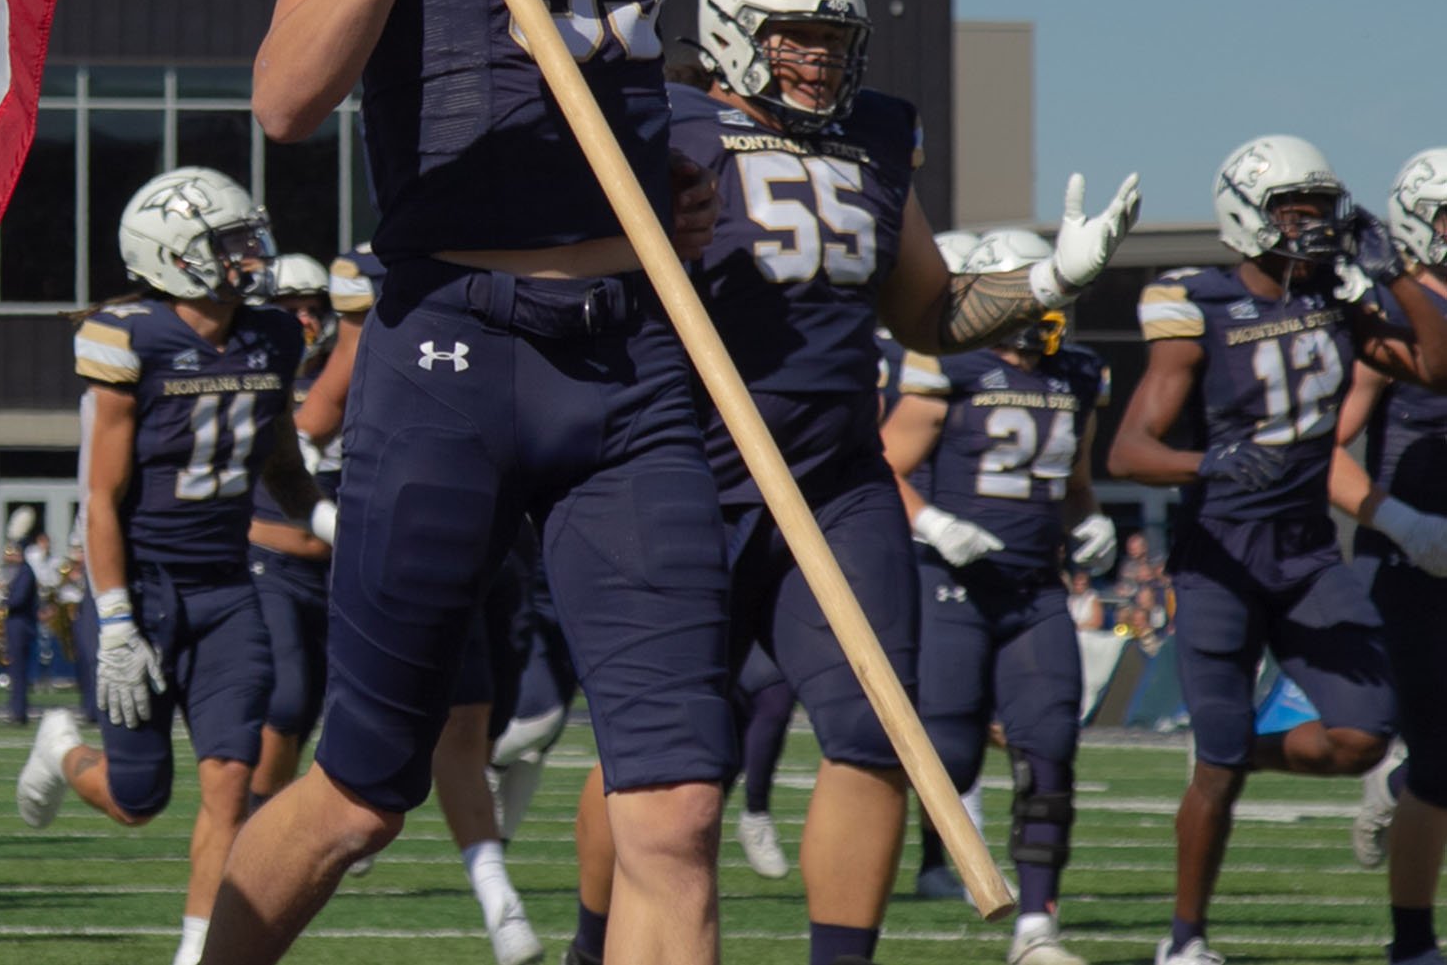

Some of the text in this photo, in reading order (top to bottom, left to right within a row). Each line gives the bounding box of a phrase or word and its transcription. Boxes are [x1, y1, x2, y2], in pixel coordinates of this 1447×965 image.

[720, 135, 815, 155] MONTANA
[736, 151, 877, 284] 55
[1226, 318, 1305, 347] MONTANA
[163, 378, 241, 396] MONTANA
[972, 391, 1046, 409] MONTANA
[1252, 330, 1343, 445] 12
[175, 394, 257, 499] 11
[976, 407, 1076, 499] 24
